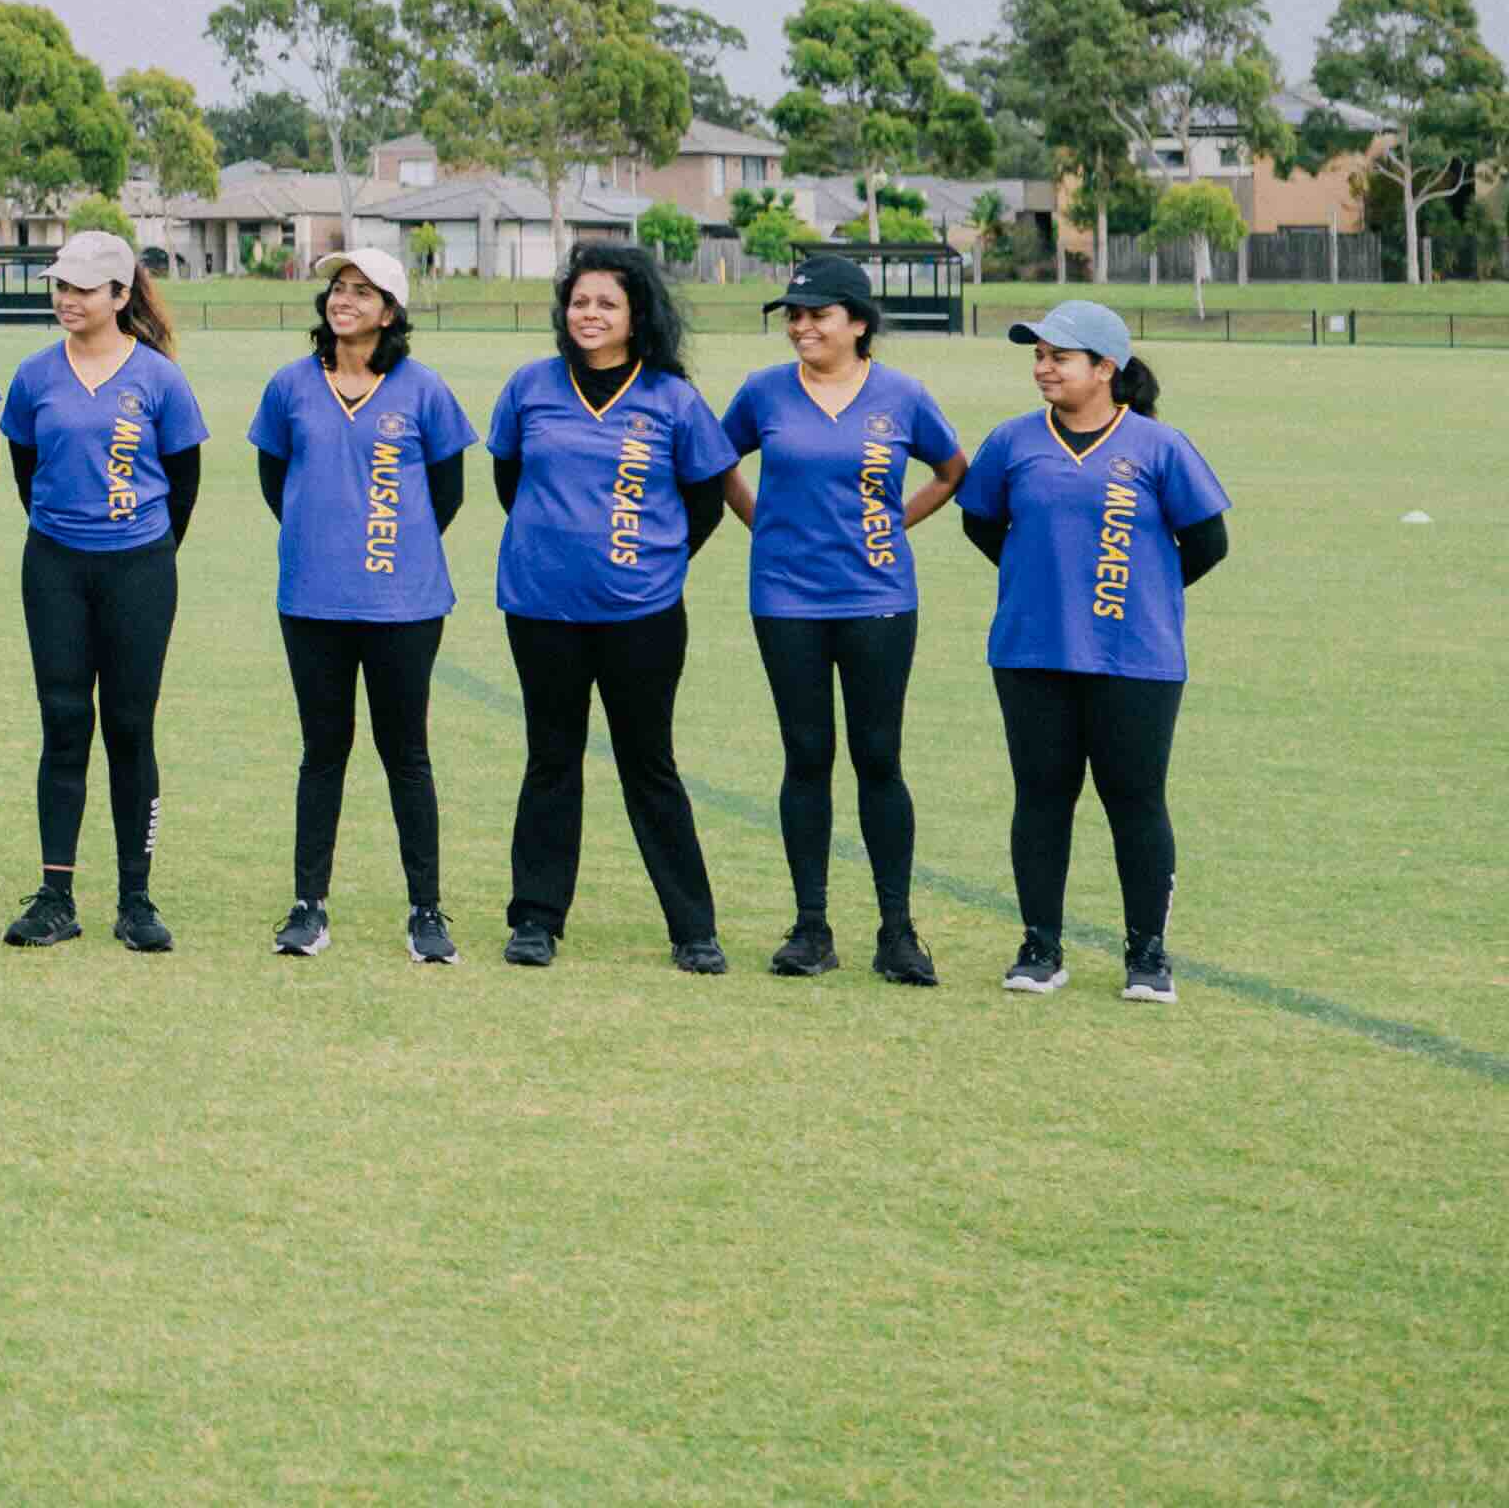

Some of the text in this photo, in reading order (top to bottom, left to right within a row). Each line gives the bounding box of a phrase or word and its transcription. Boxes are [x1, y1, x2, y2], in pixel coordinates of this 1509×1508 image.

[365, 442, 403, 573] MUSAEUS
[610, 438, 652, 566] MUSAEUS
[859, 442, 895, 568] MUSAEUS
[1093, 482, 1138, 620] MUSAEUS
